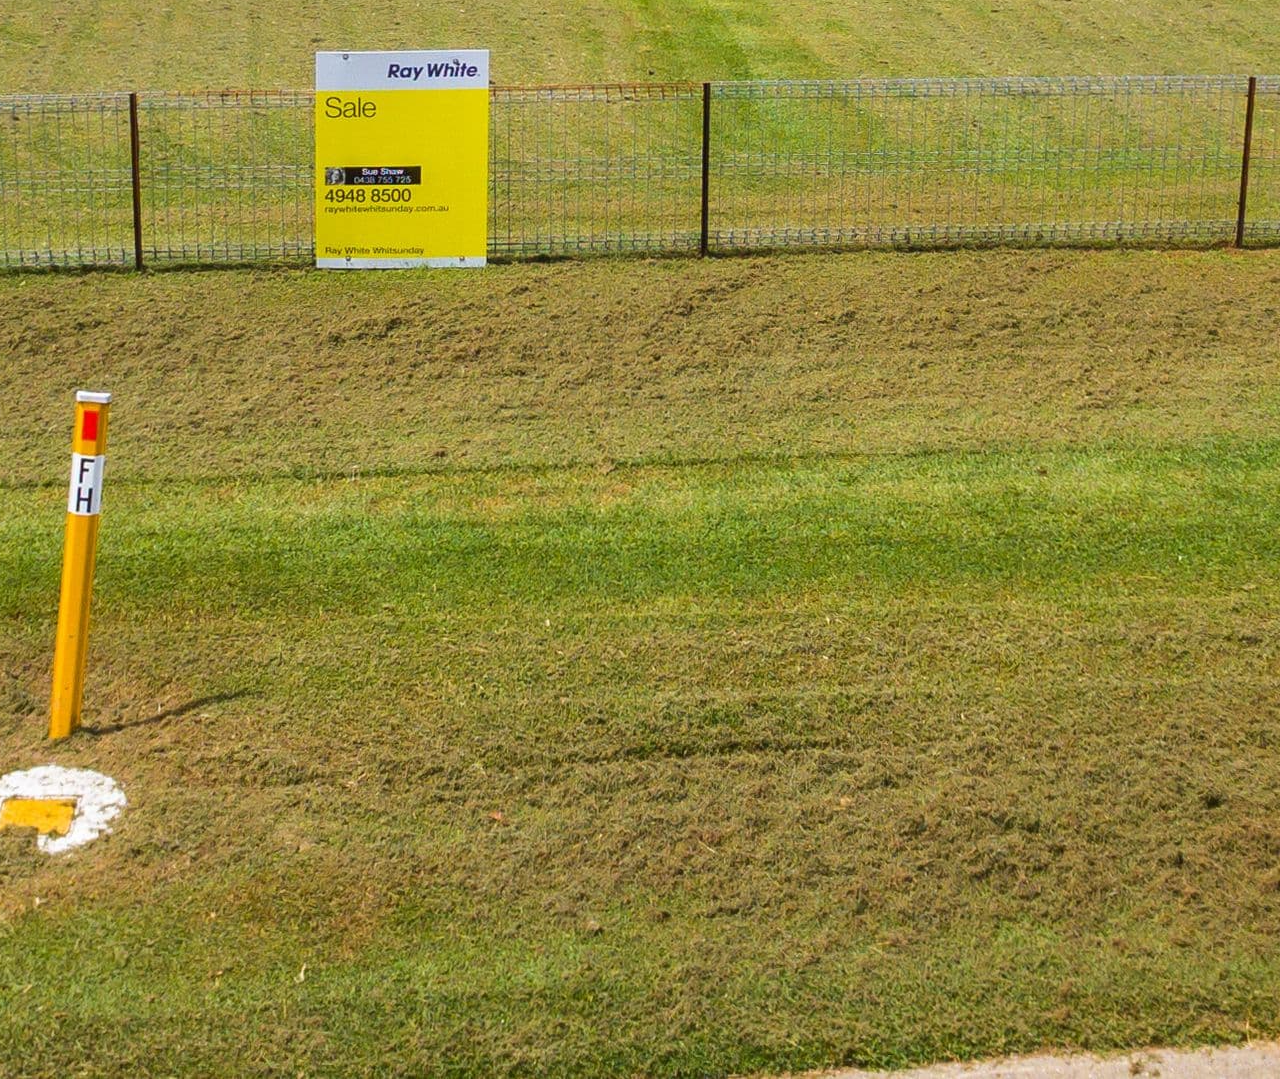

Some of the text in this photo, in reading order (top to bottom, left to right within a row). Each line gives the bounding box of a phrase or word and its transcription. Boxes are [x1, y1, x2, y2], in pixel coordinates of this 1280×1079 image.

[388, 61, 478, 81] Ray White
[325, 96, 377, 118] Sale
[325, 188, 412, 203] 4948 8500
[325, 246, 424, 255] Ray White Whitsunday
